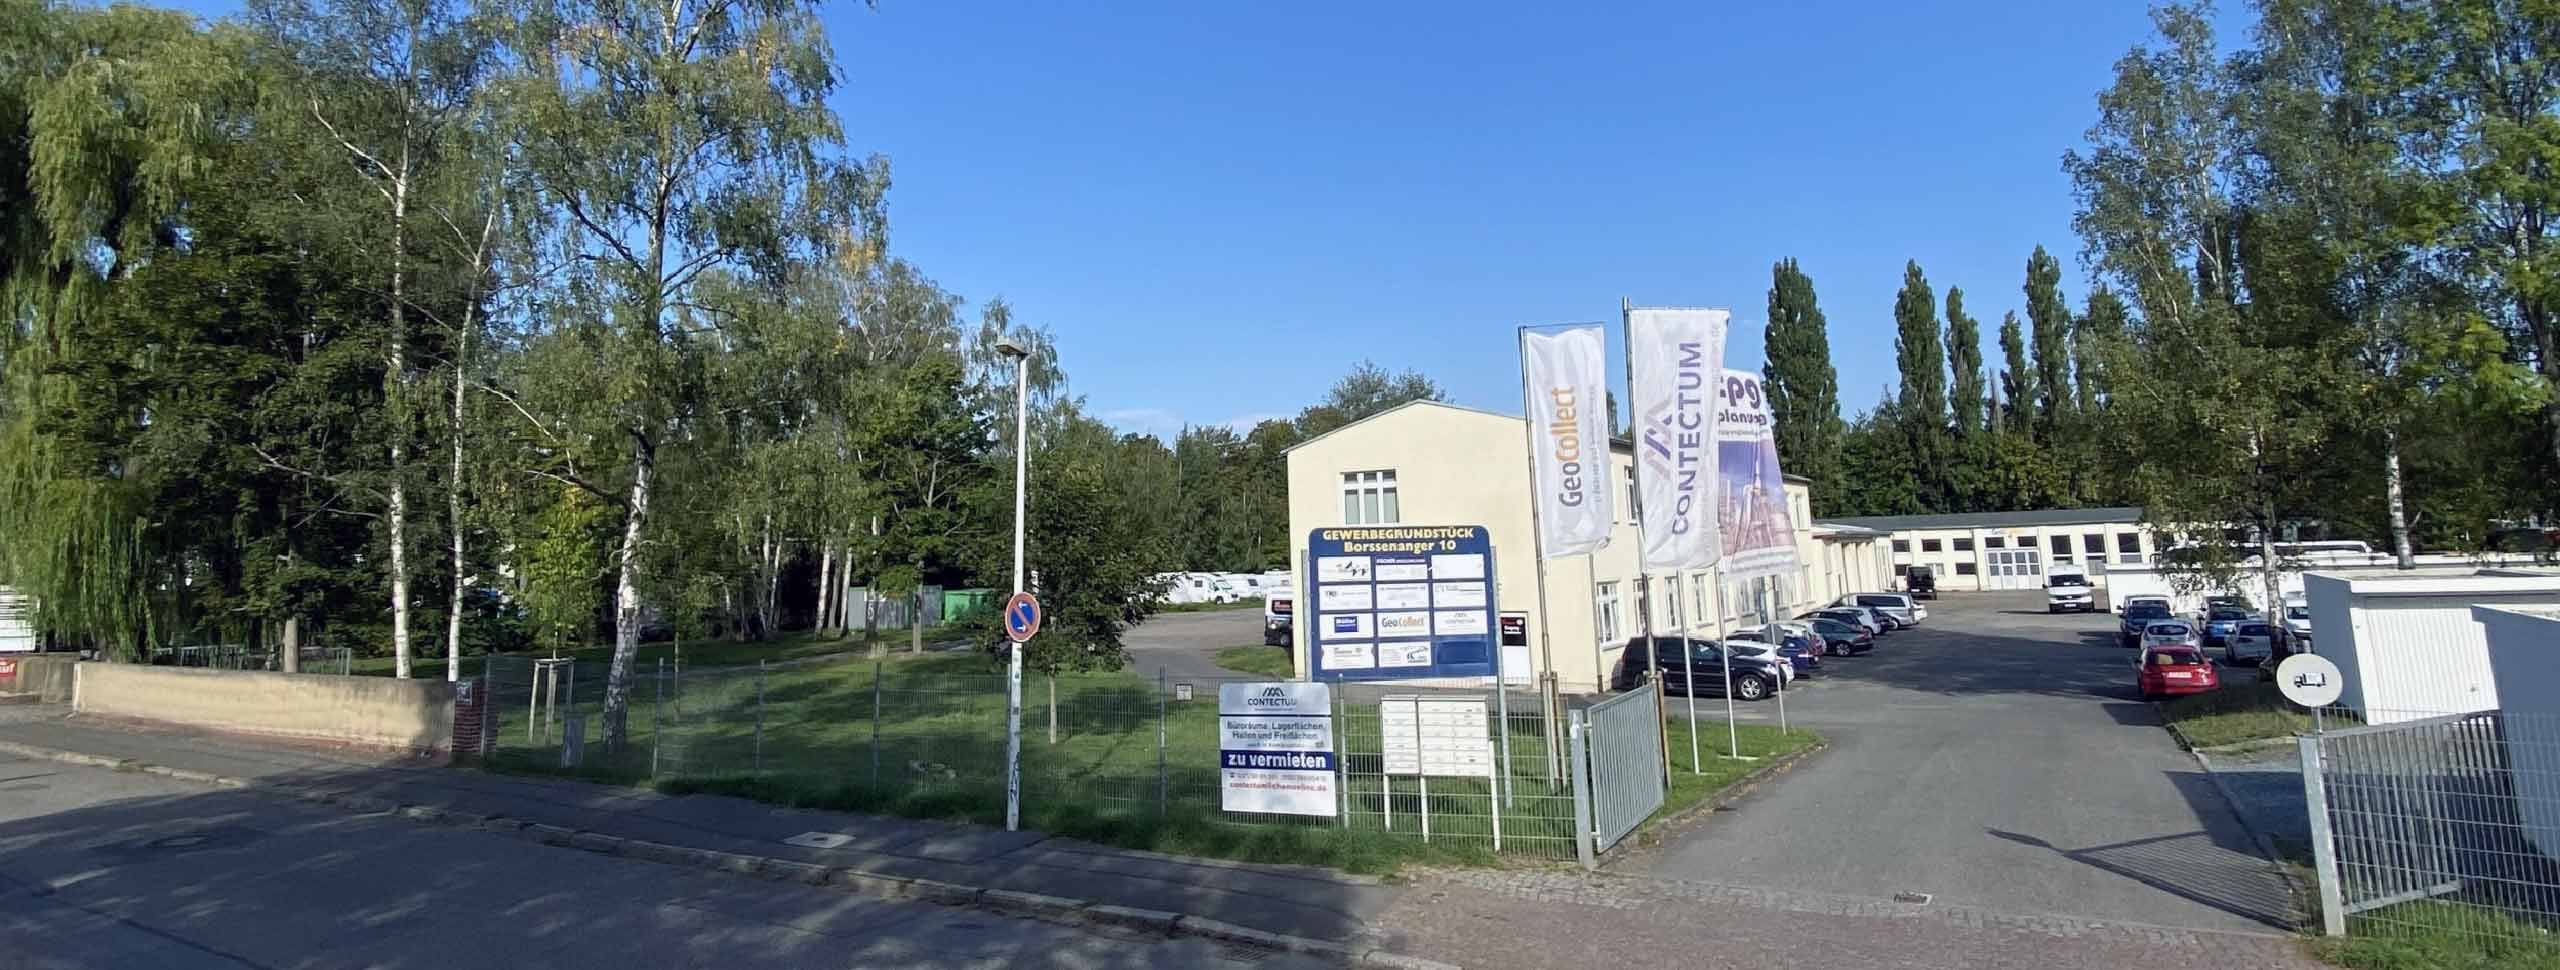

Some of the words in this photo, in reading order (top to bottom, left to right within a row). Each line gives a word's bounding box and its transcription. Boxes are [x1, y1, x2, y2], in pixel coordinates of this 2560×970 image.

[1551, 386, 1583, 507] GeoCollect
[1672, 342, 1702, 536] CONTECTUM
[1323, 527, 1474, 541] GEWERBEGRUNDSTÜCK
[1344, 541, 1435, 554] Borssenanger
[1439, 540, 1457, 550] 10
[1228, 754, 1246, 766] zu
[1249, 752, 1327, 769] vermieten
